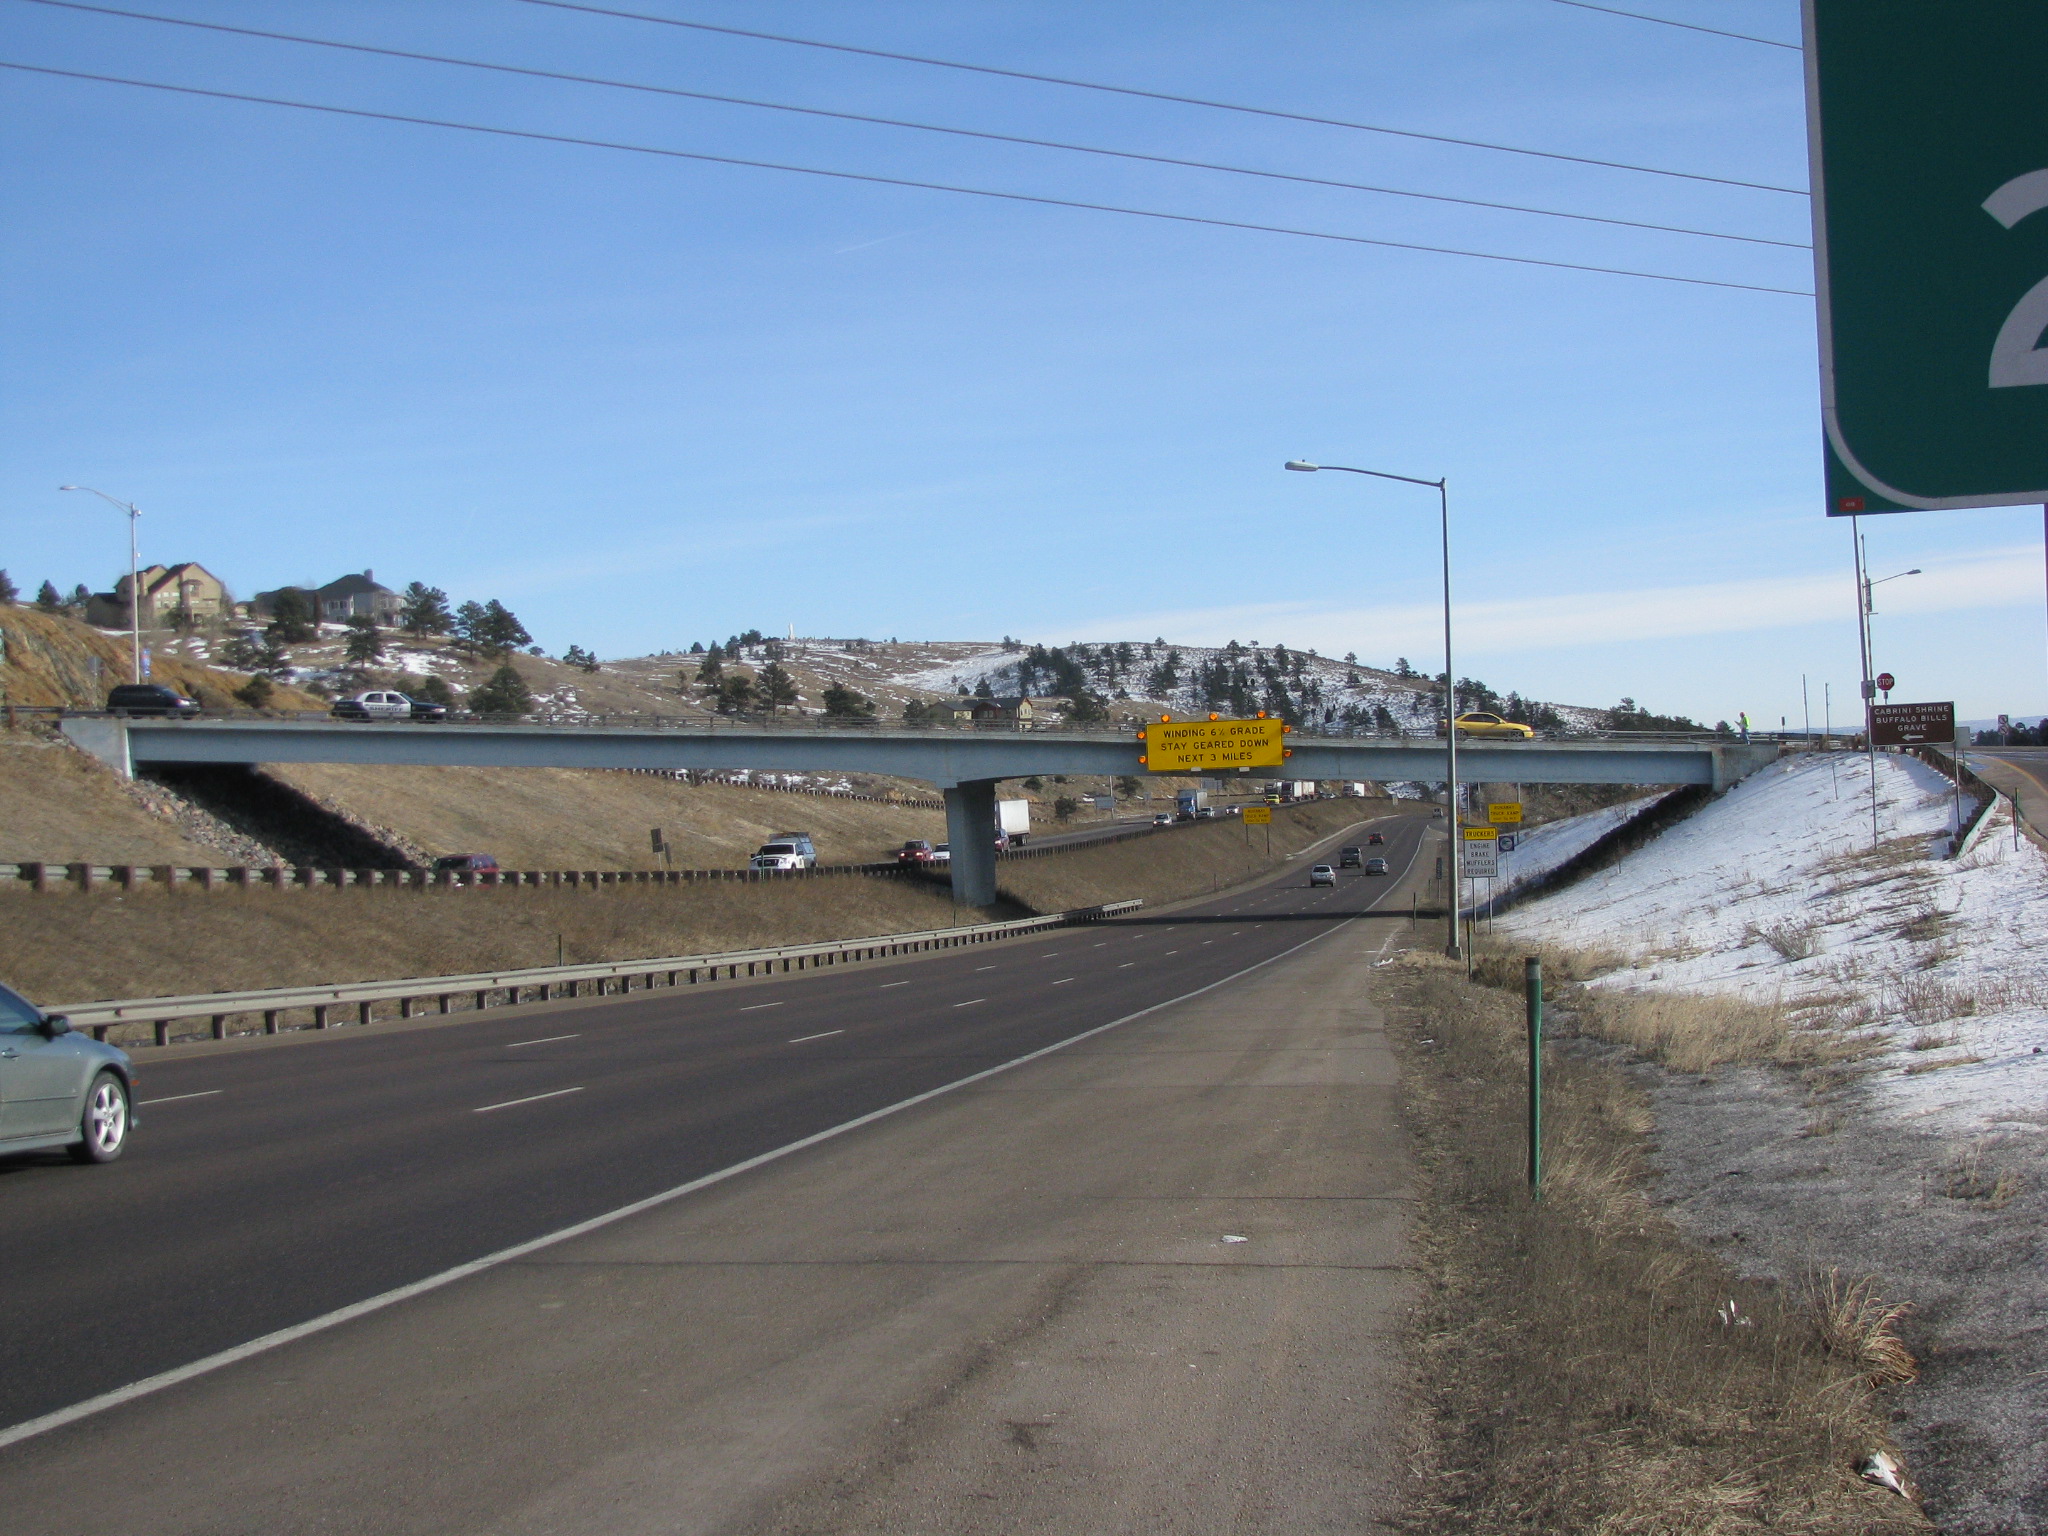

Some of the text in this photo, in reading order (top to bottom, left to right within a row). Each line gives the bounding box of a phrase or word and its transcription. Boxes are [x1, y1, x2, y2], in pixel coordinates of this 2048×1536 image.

[1877, 678, 1894, 686] STOP
[1874, 705, 1949, 715] CABRINI SHRINE
[1875, 714, 1947, 724] BUFFALO BILLS
[1163, 728, 1205, 738] WINDING
[1230, 726, 1265, 736] GRADE
[1897, 723, 1927, 732] GRAVE
[1161, 738, 1269, 751] STAY GEARED DOWN
[1177, 751, 1253, 763] NEXT 3 MILES
[1466, 830, 1495, 838] TRUCKERS
